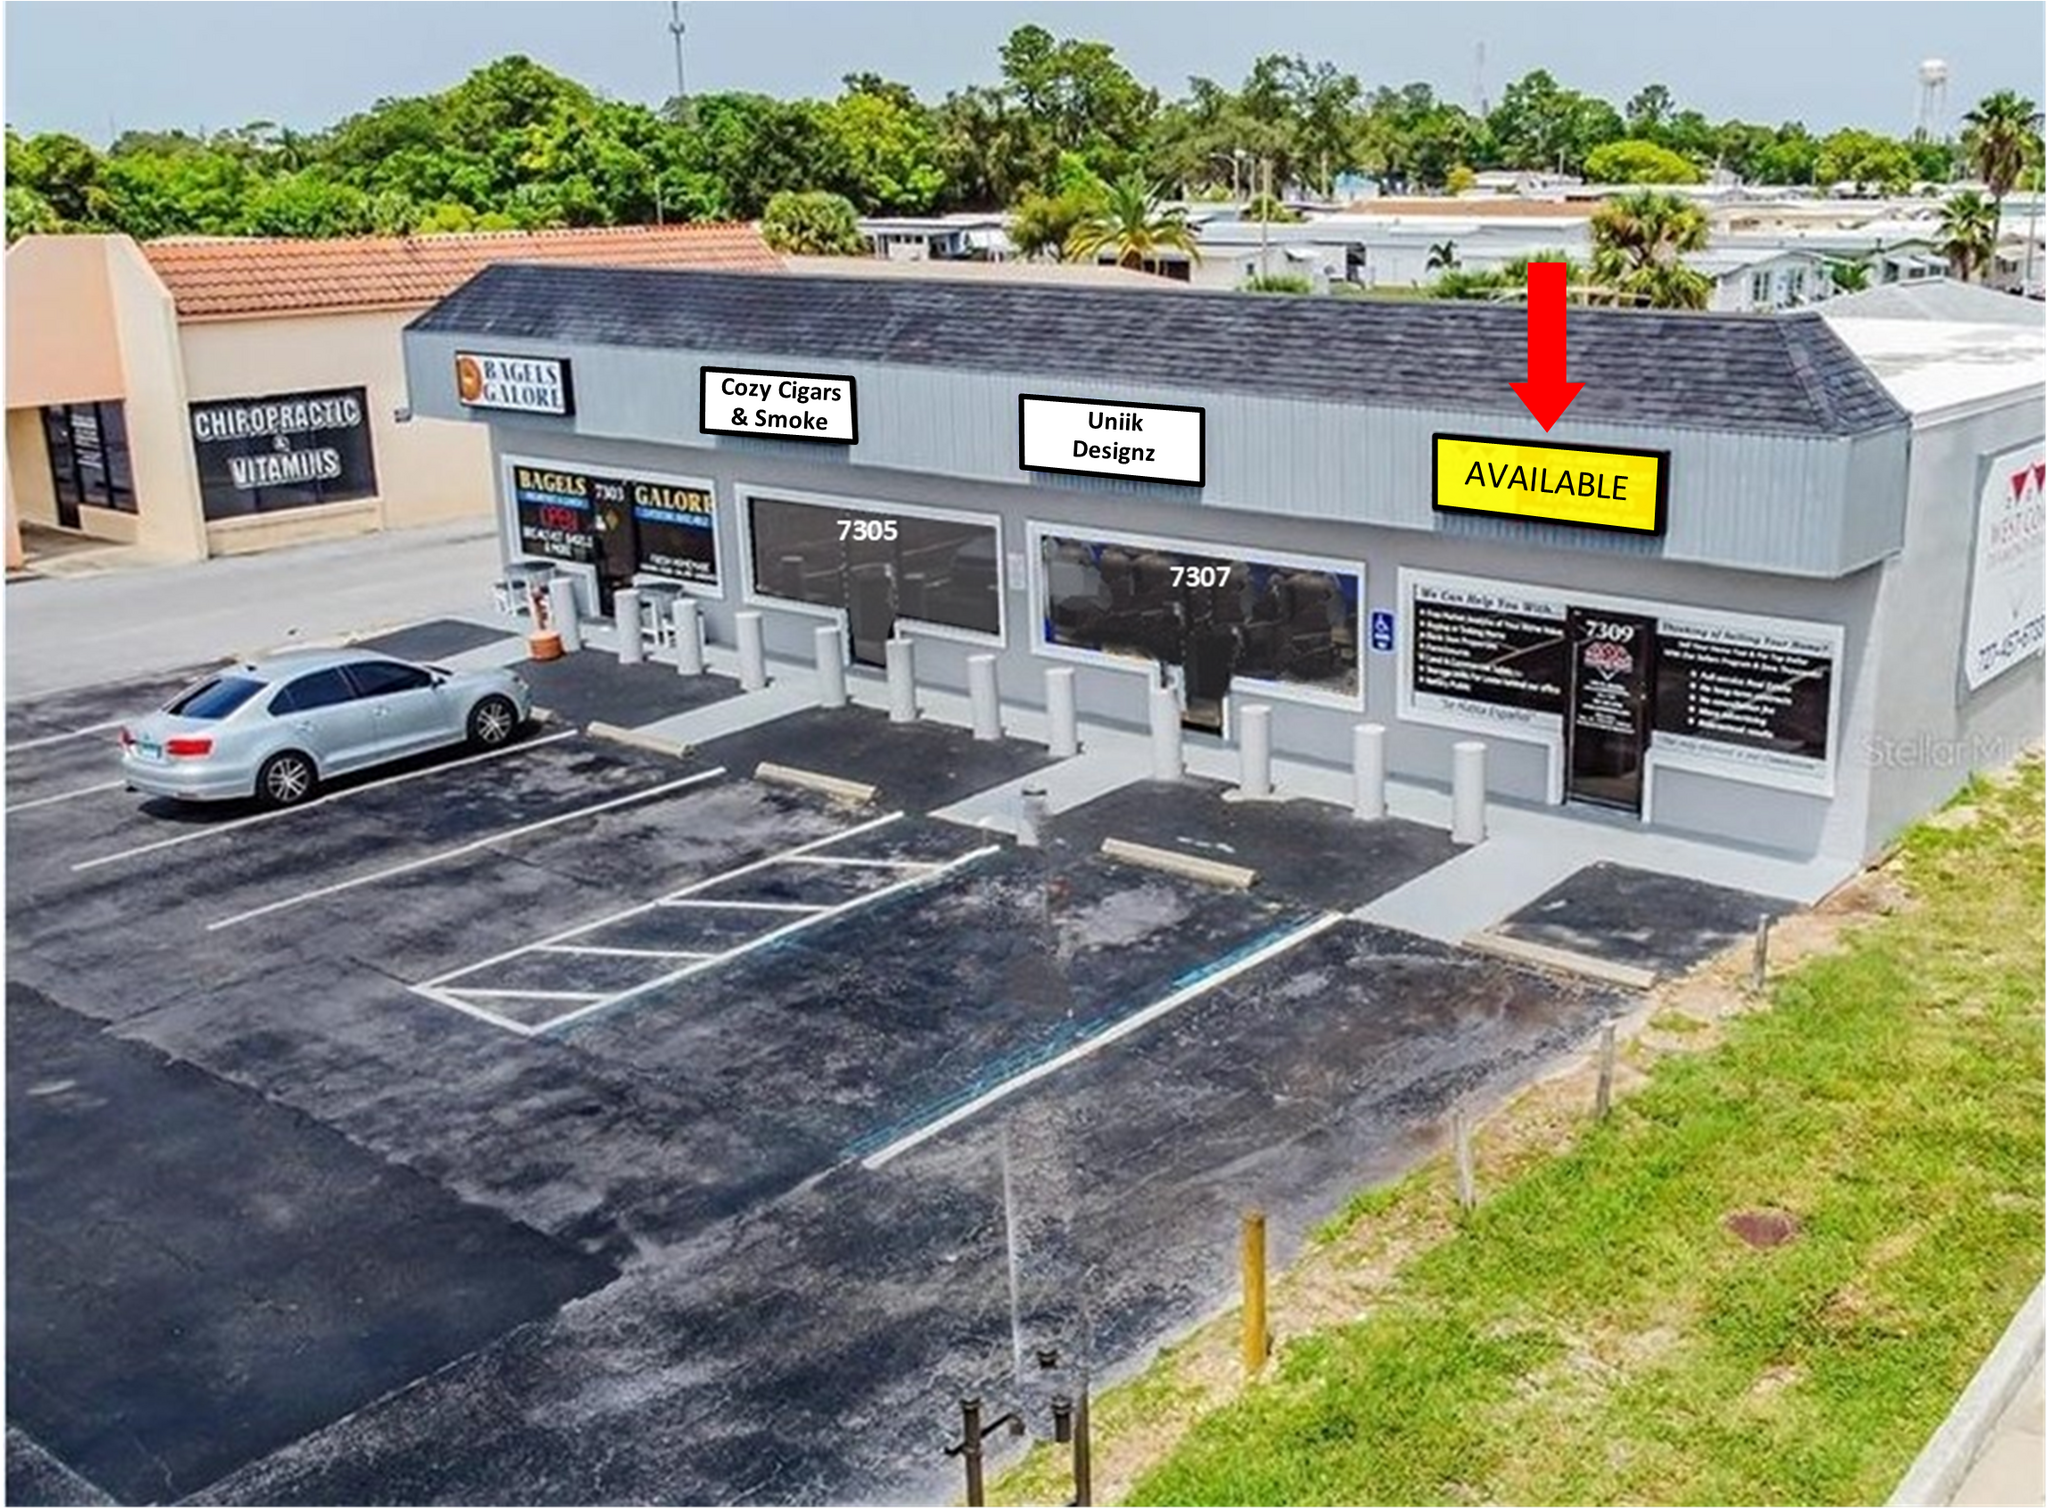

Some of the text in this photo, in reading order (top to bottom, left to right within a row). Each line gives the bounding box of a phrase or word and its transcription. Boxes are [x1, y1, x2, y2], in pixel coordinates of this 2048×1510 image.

[484, 360, 557, 385] BAGELS
[483, 383, 558, 408] GALORE
[195, 398, 361, 441] CHIROPRACTIC
[229, 448, 341, 489] VITAMINS
[519, 469, 587, 496] BAGELS
[1441, 590, 1463, 602] Can
[1467, 594, 1493, 608] Help
[1498, 598, 1518, 610] You
[1586, 619, 1634, 642] 7309
